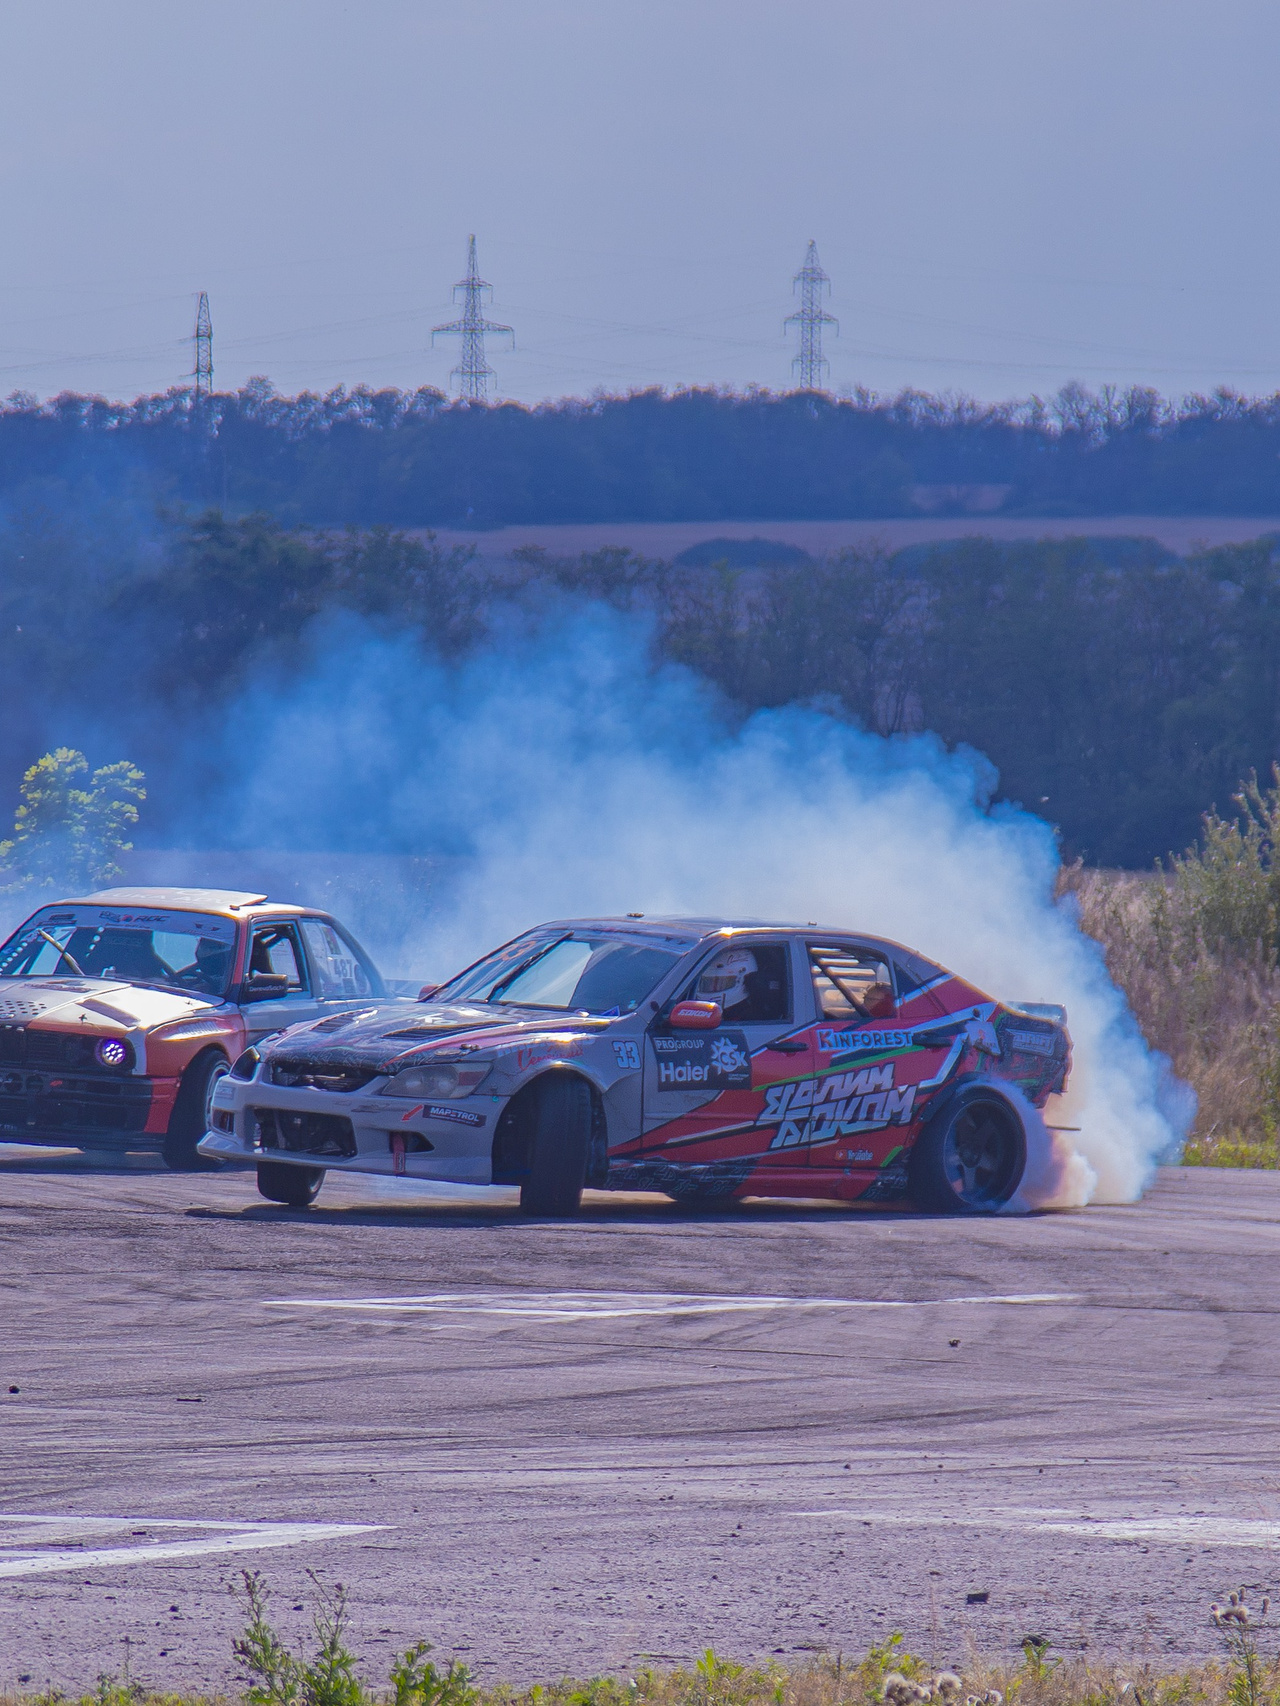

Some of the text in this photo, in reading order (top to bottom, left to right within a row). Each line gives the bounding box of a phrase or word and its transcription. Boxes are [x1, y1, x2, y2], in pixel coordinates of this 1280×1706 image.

[818, 1030, 913, 1049] KINFOREST
[612, 1041, 641, 1070] 33
[660, 1060, 709, 1082] Haier
